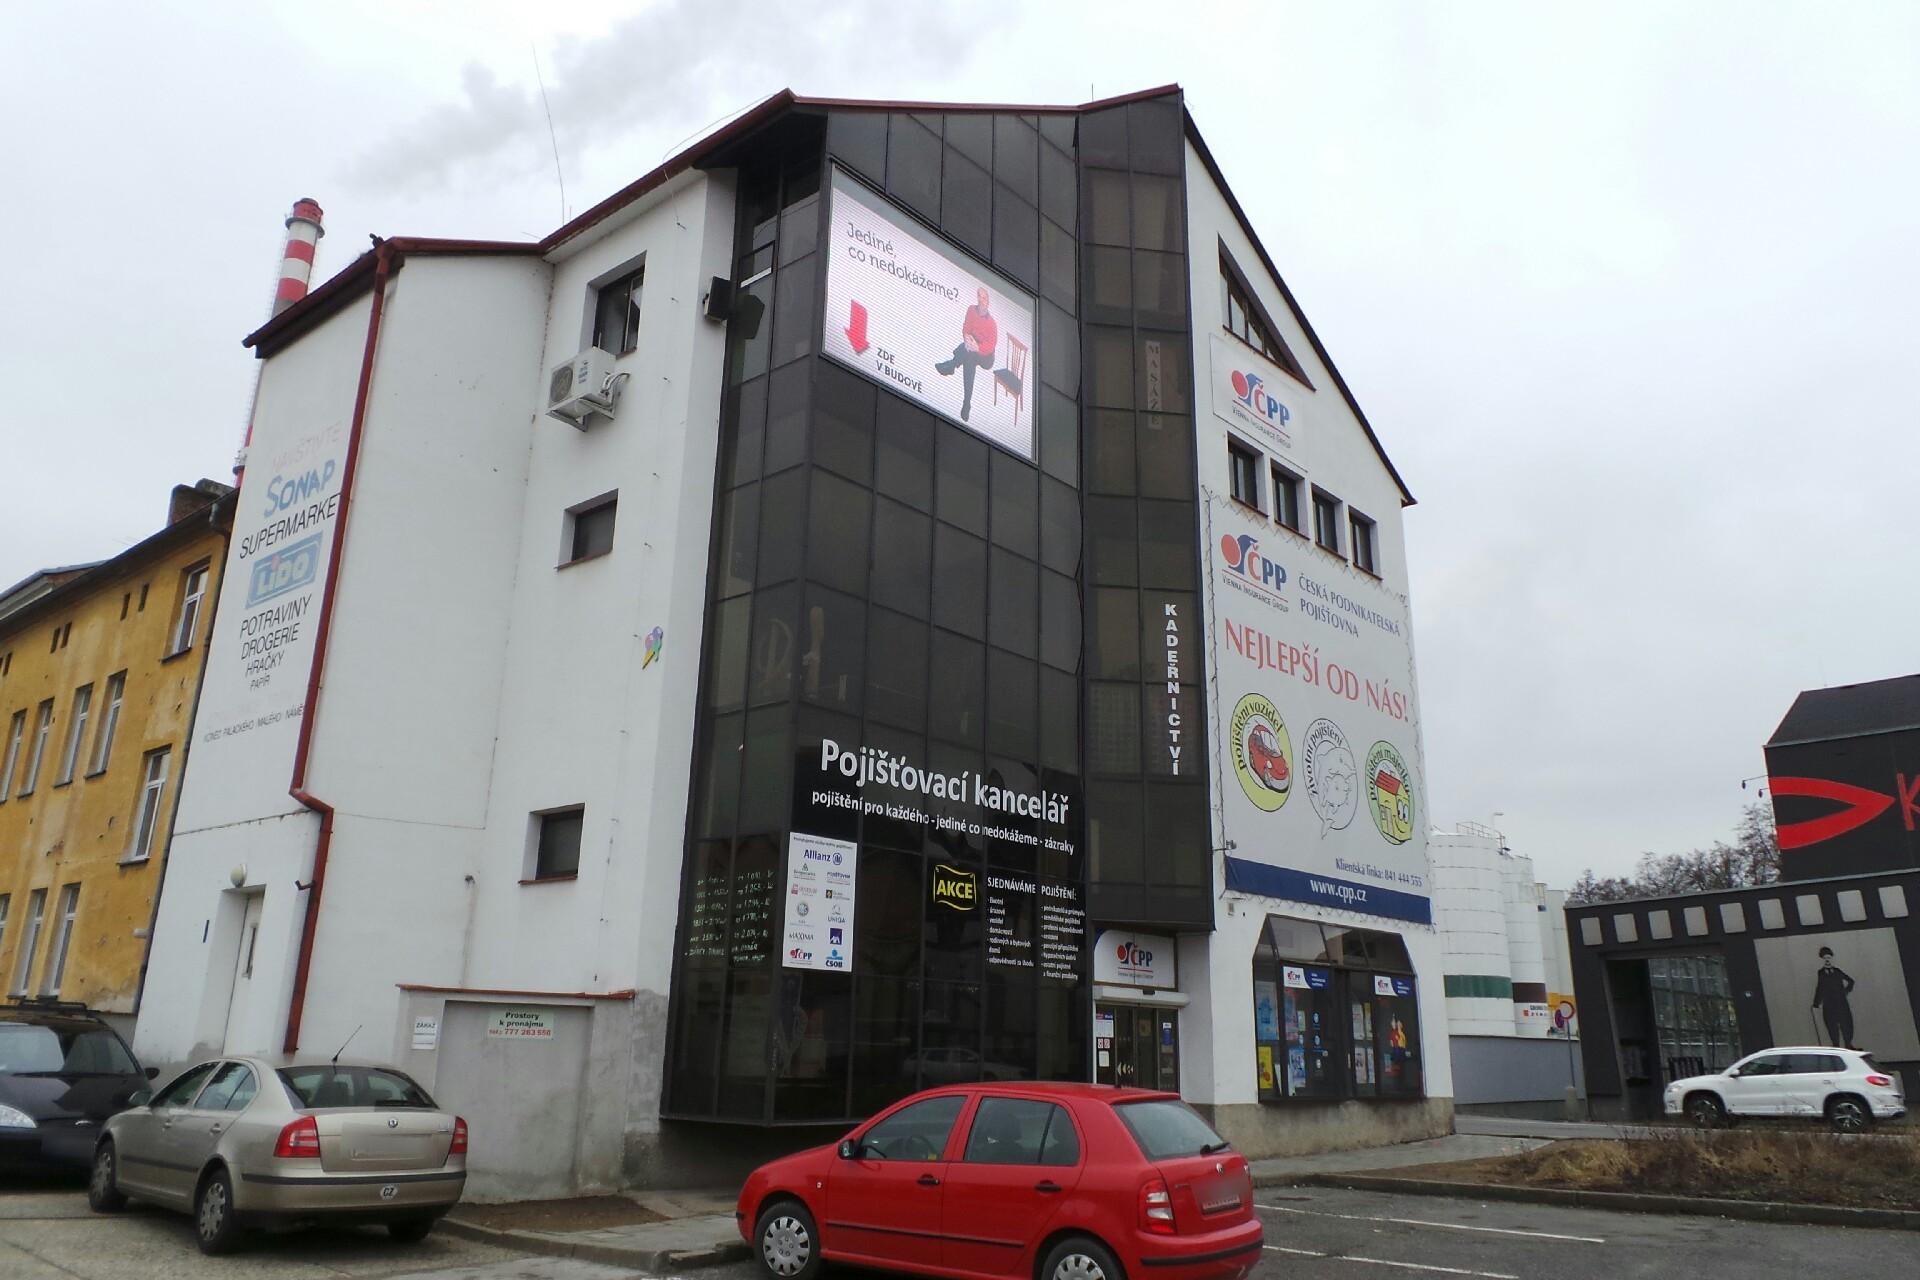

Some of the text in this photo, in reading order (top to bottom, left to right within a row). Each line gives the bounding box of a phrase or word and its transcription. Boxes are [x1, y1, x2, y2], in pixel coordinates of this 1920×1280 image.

[847, 222, 898, 259] Jediné,
[848, 244, 960, 303] co nedokážeme?
[876, 360, 883, 371] V
[877, 347, 895, 365] ZDE
[1254, 384, 1290, 428] ČPP
[240, 493, 341, 559] SUPERMARKE
[1248, 543, 1287, 593] ČPP
[240, 594, 312, 639] POTRAVINY
[1299, 573, 1400, 637] ČESKÁ PODNIKATELSKÁ
[241, 623, 300, 660] DROGERIE
[245, 651, 285, 678] HRAČKY
[1225, 618, 1409, 722] NEJLEPŠÍ OD NÁS!
[1164, 603, 1181, 776] KADEŘNICTVÍ
[1249, 702, 1283, 733] vozidel
[821, 739, 1069, 825] Pojišťovací kancelář
[812, 790, 863, 811] pojištění
[864, 801, 884, 816] pro
[885, 802, 930, 824] každého
[936, 814, 966, 833] jediné
[968, 824, 980, 835] co
[981, 825, 1038, 846] nedokážeme
[1044, 837, 1075, 855] zázraky
[804, 849, 831, 862] Allianz
[1335, 858, 1365, 876] Klientská
[1384, 869, 1396, 881] 841
[1398, 873, 1410, 884] 444
[1410, 875, 1422, 887] 555
[936, 879, 973, 900] AKCE
[987, 876, 1077, 901] SJEDNÁVÁME POJIŠTĚNÍ:
[1310, 879, 1367, 904] www.cpp.cz
[1131, 944, 1153, 967] ČPP
[505, 1011, 540, 1020] Prostory
[506, 1020, 544, 1028] pronájmu
[383, 1187, 395, 1197] CZ
